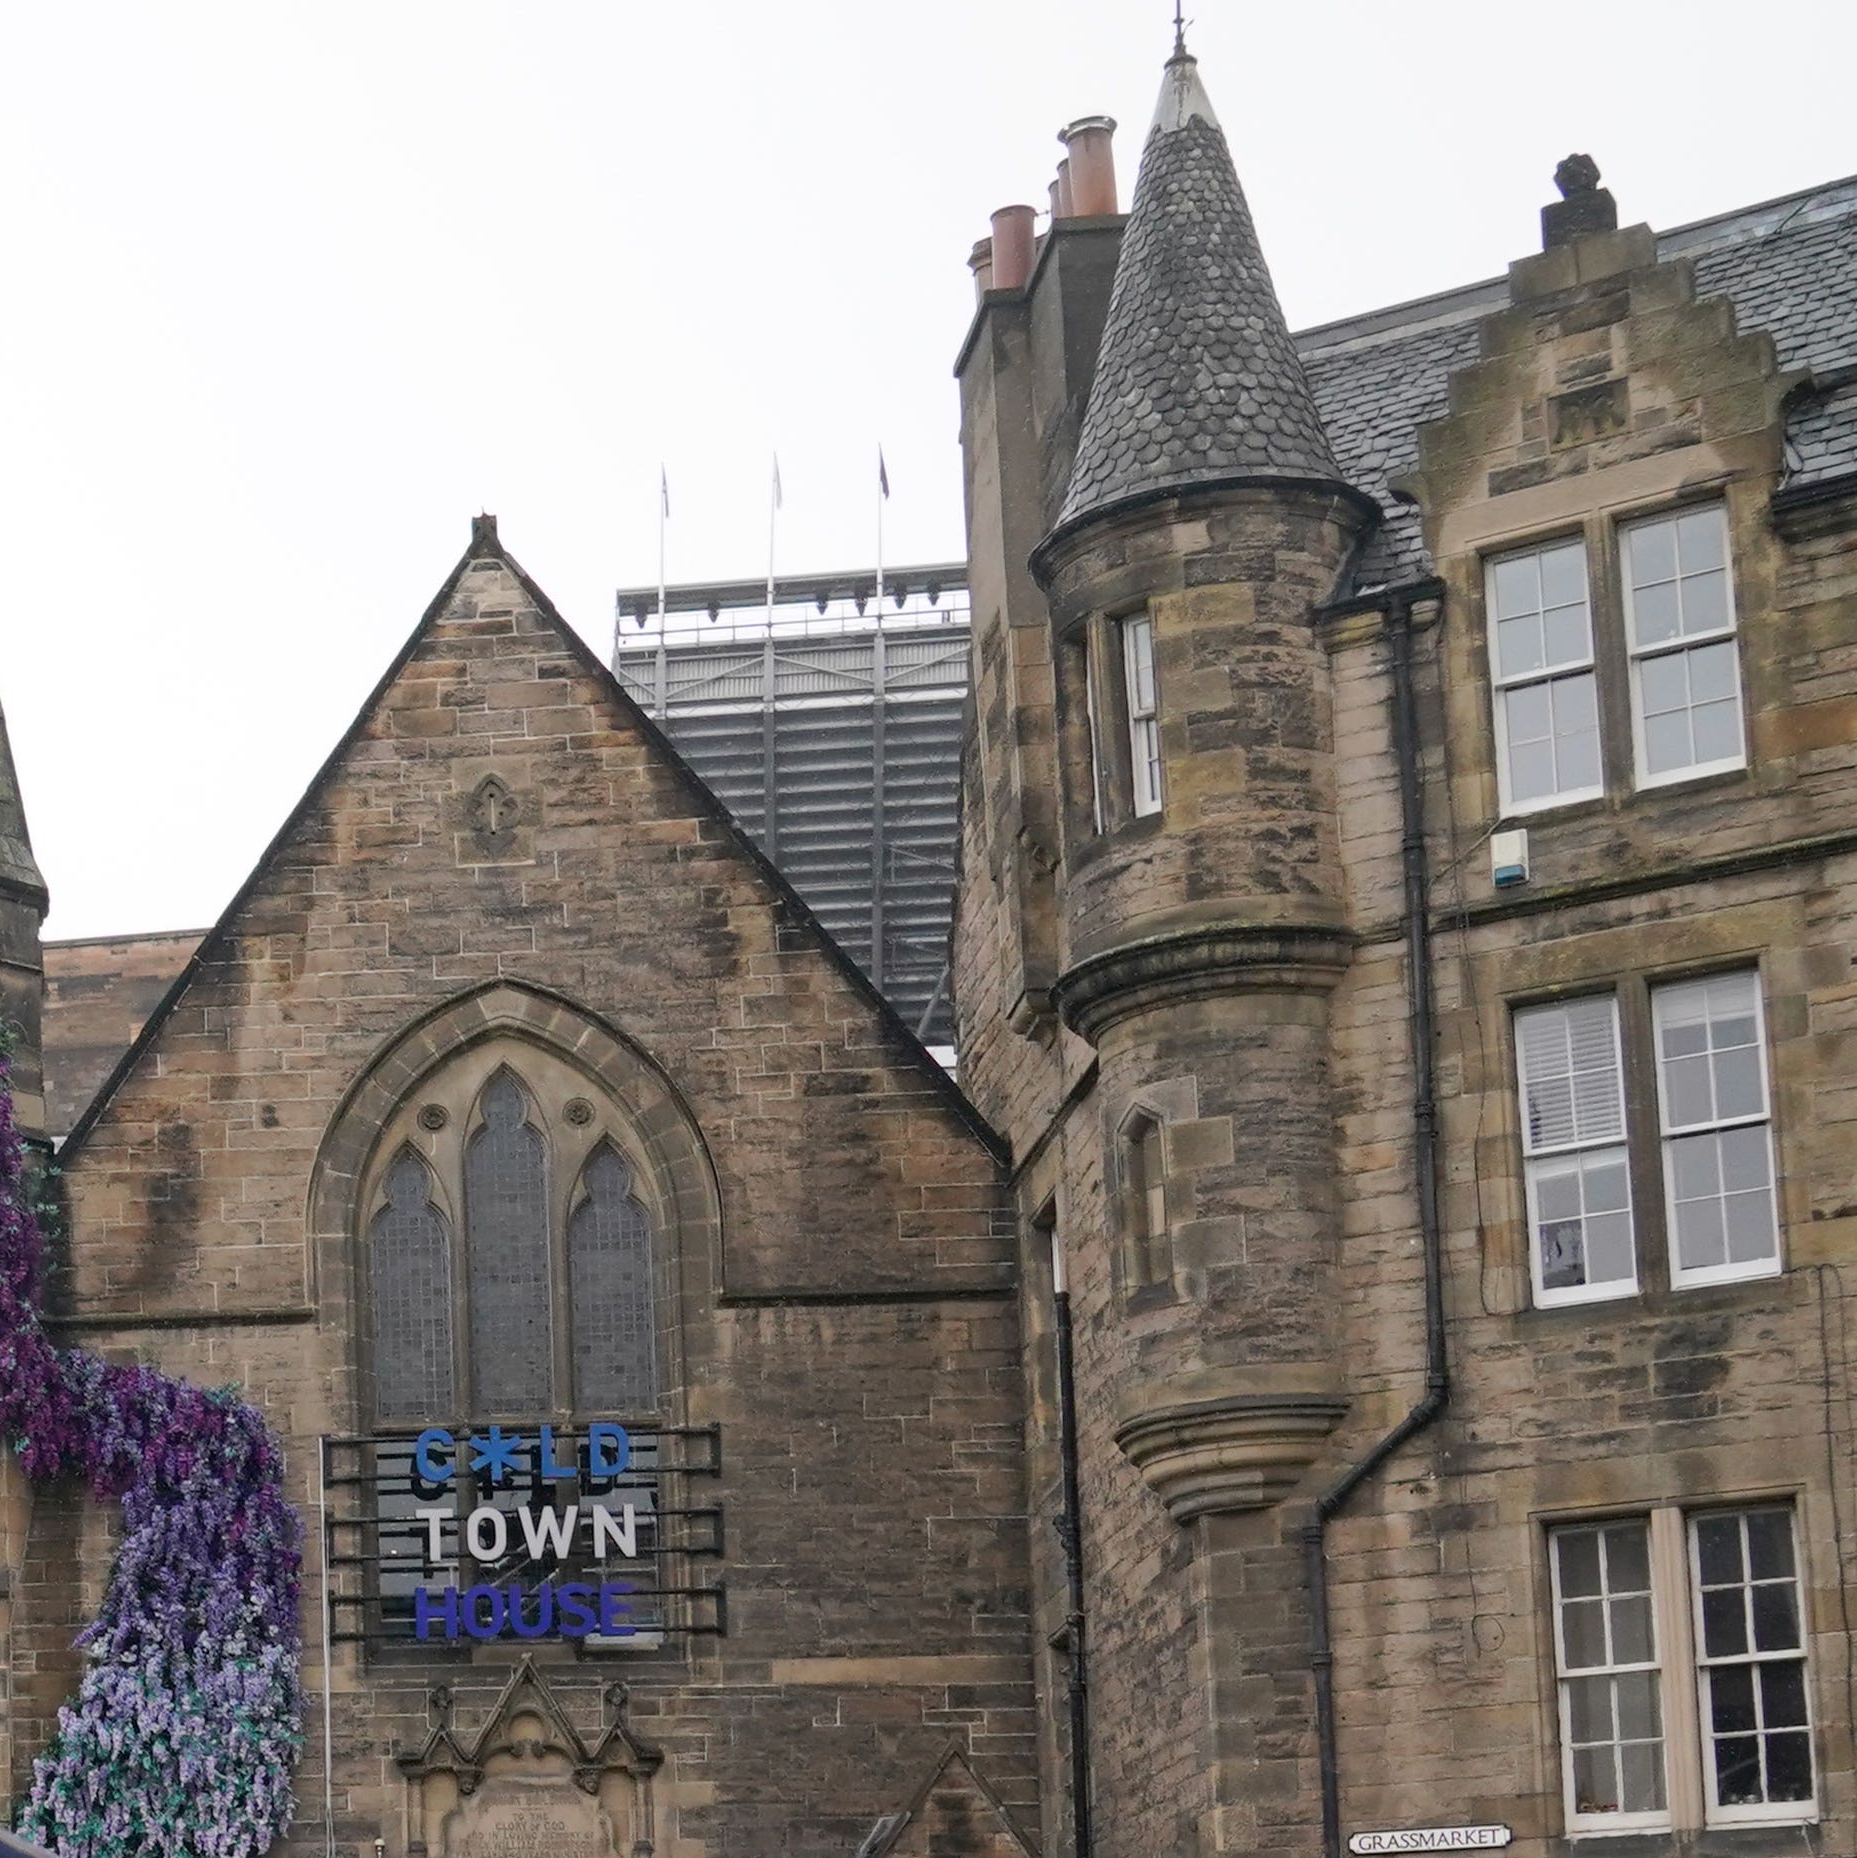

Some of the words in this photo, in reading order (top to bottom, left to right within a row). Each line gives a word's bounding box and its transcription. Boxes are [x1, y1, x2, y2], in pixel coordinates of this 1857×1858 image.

[415, 1503, 638, 1562] TOWN
[414, 1582, 637, 1641] HOUSE
[1358, 1828, 1501, 1851] GRASSMARKET
